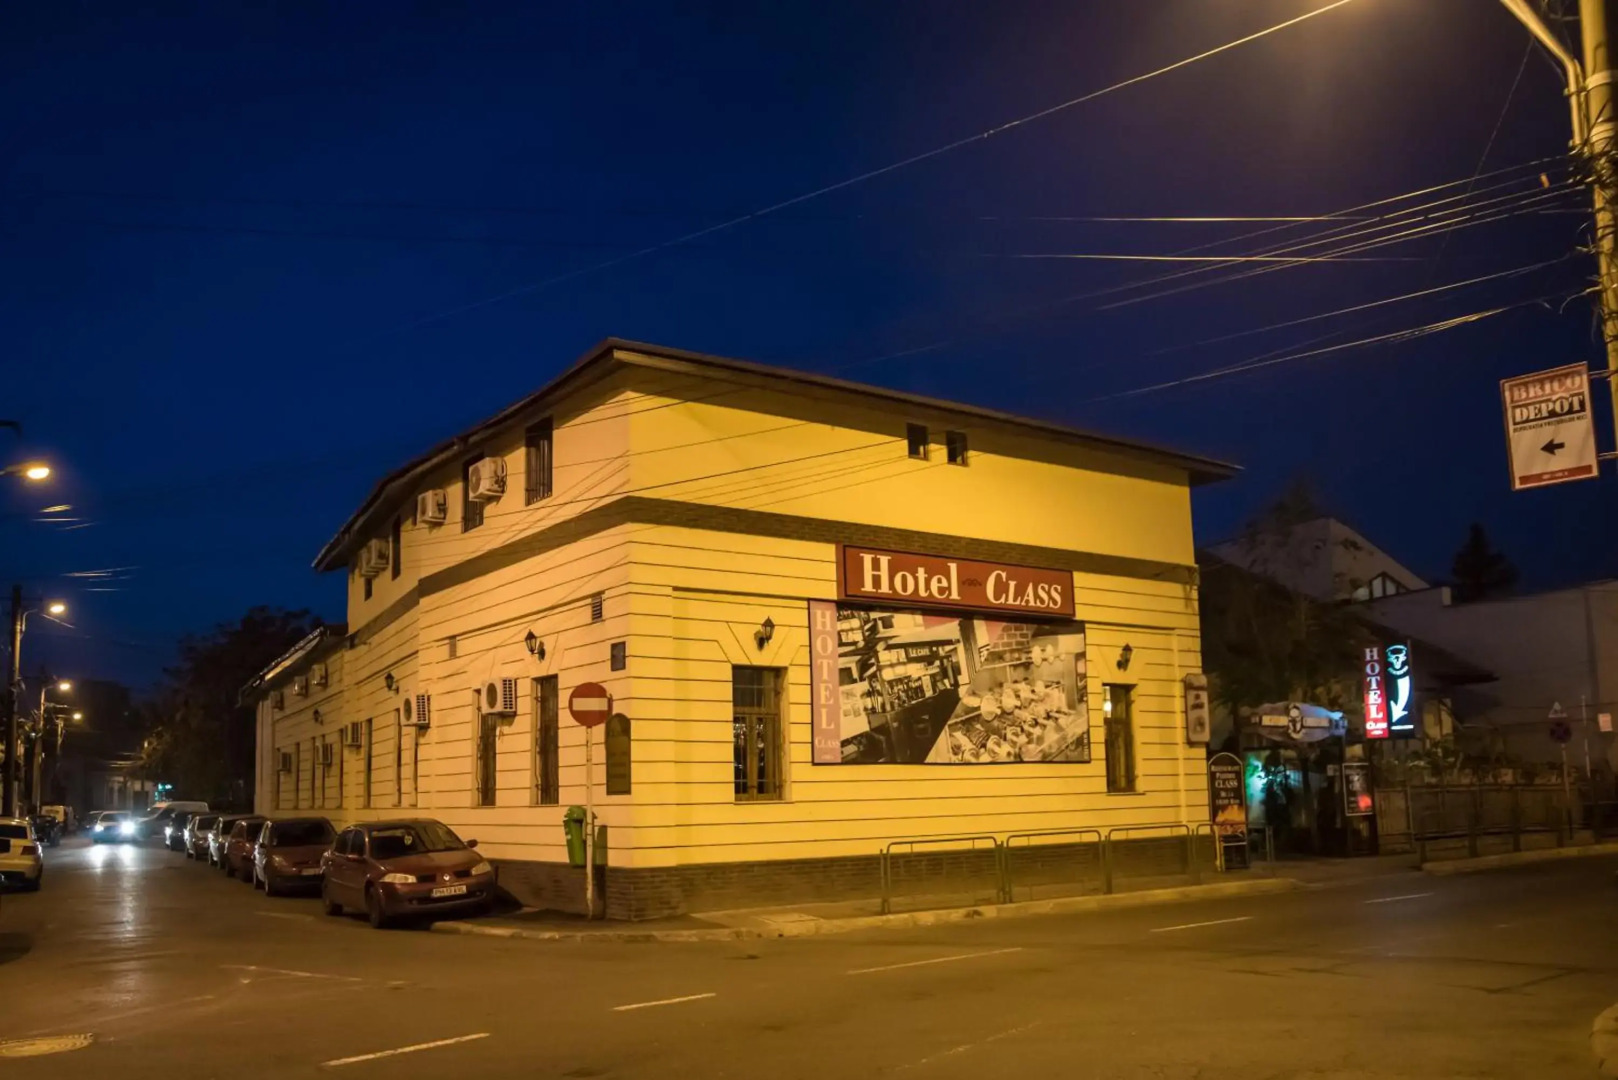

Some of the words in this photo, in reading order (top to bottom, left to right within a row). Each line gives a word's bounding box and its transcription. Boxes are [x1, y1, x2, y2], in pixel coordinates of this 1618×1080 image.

[1512, 372, 1583, 401] BRICO
[1513, 394, 1584, 423] DEPOT
[860, 553, 961, 600] Hotel
[986, 570, 1062, 609] CLASS
[815, 609, 835, 730] HOTEL
[1364, 647, 1384, 719] HOTEL
[1215, 779, 1238, 788] CLASS
